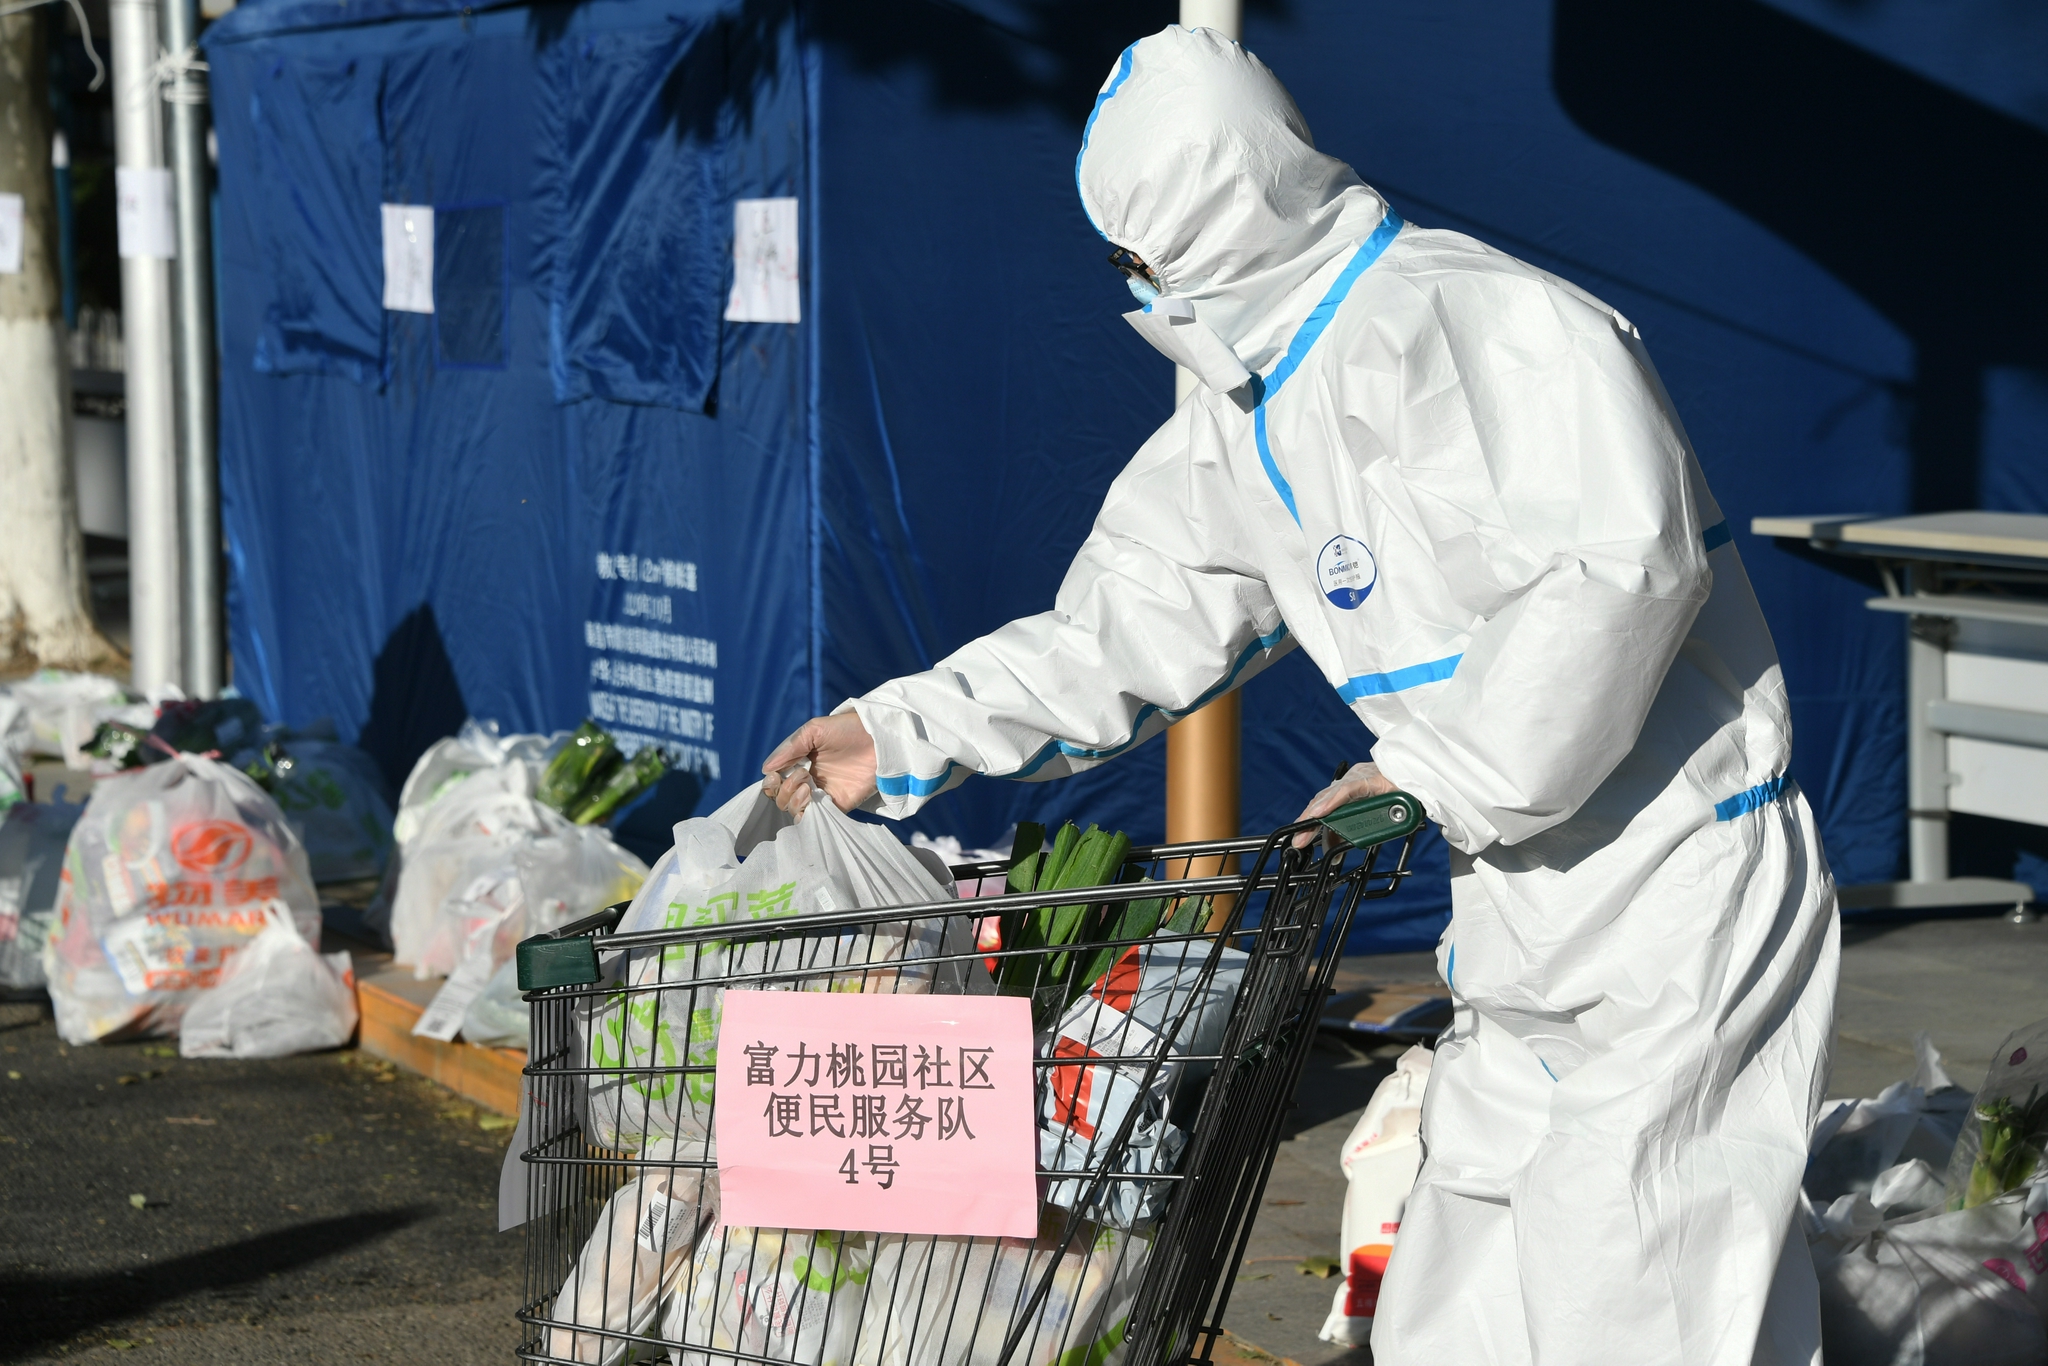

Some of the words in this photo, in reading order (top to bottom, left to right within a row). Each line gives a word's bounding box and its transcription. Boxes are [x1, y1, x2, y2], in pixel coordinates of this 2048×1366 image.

[146, 909, 277, 927] WUMAR
[743, 1040, 996, 1091] 富力桃园社区
[763, 1091, 976, 1141] 便民服务队
[838, 1144, 900, 1190] 4号
